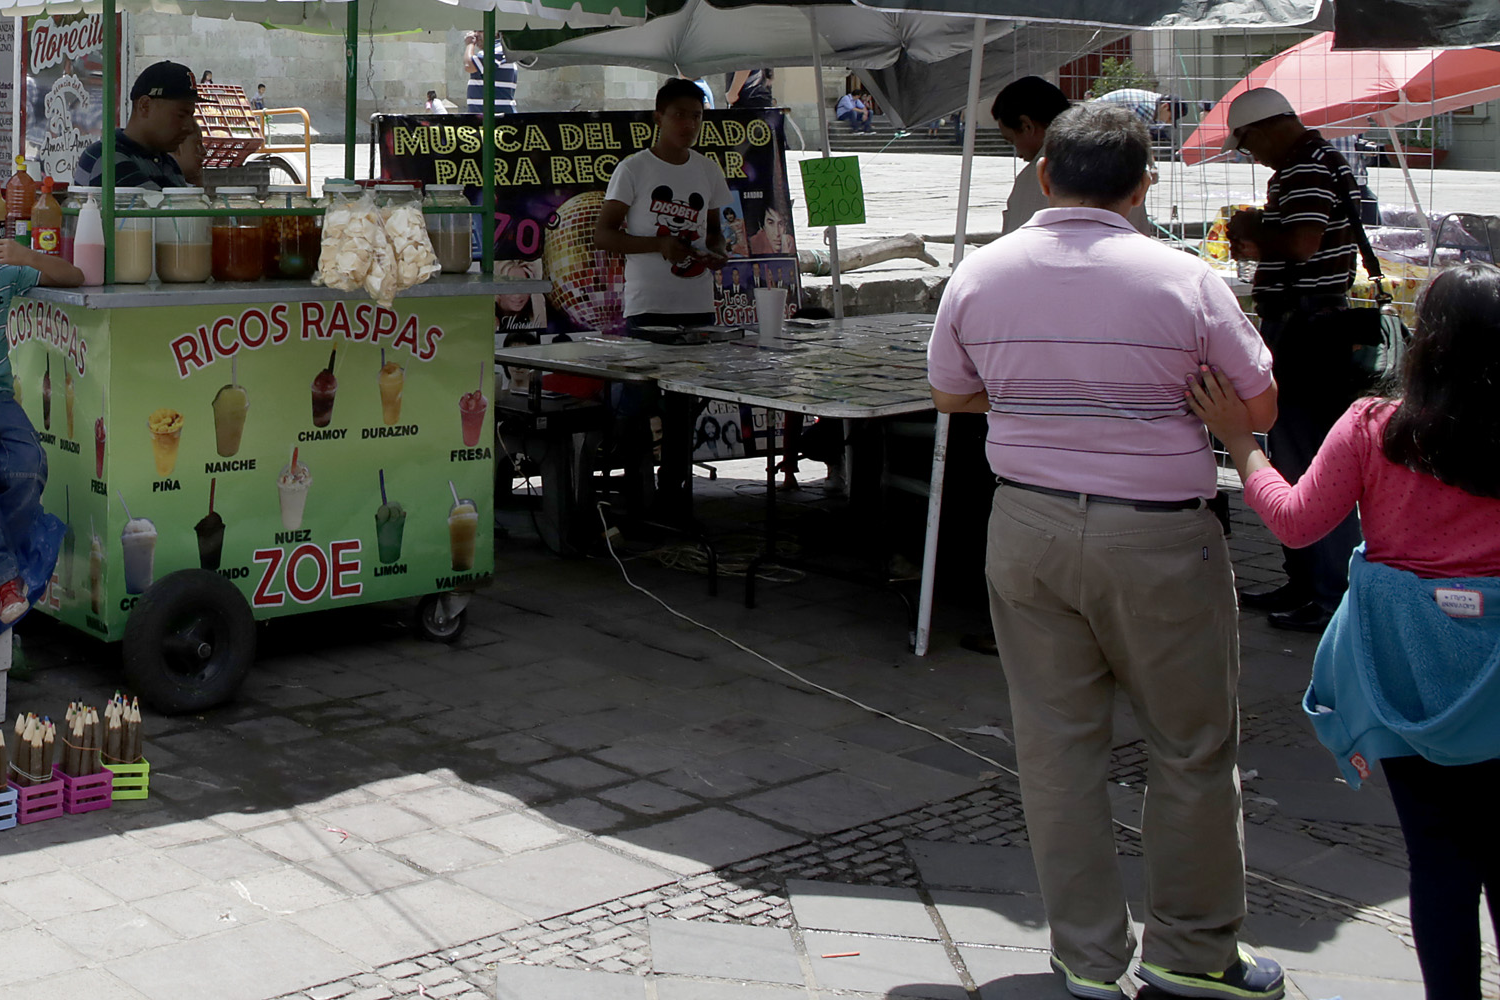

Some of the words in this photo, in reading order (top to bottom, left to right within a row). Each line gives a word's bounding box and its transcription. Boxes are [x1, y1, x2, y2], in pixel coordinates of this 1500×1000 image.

[41, 137, 65, 157] Amor
[69, 133, 93, 152] Amor
[559, 122, 622, 151] DEL
[433, 157, 542, 188] PARA
[744, 189, 764, 200] SANDRO
[650, 200, 700, 222] DISOBEY
[724, 289, 748, 307] Los
[499, 313, 541, 332] Marisela
[35, 302, 88, 377] RASPAS
[171, 303, 289, 378] RICOS
[301, 301, 444, 361] RASPAS
[152, 479, 181, 493] PIÑA
[204, 459, 257, 474] NANCHE
[297, 428, 348, 442] CHAMOY
[361, 424, 419, 440] DURAZNO
[449, 446, 492, 462] FRESA
[90, 478, 108, 498] FRESA
[274, 530, 312, 545] NUEZ
[373, 562, 408, 577] LIMÓN
[253, 540, 363, 609] ZOE
